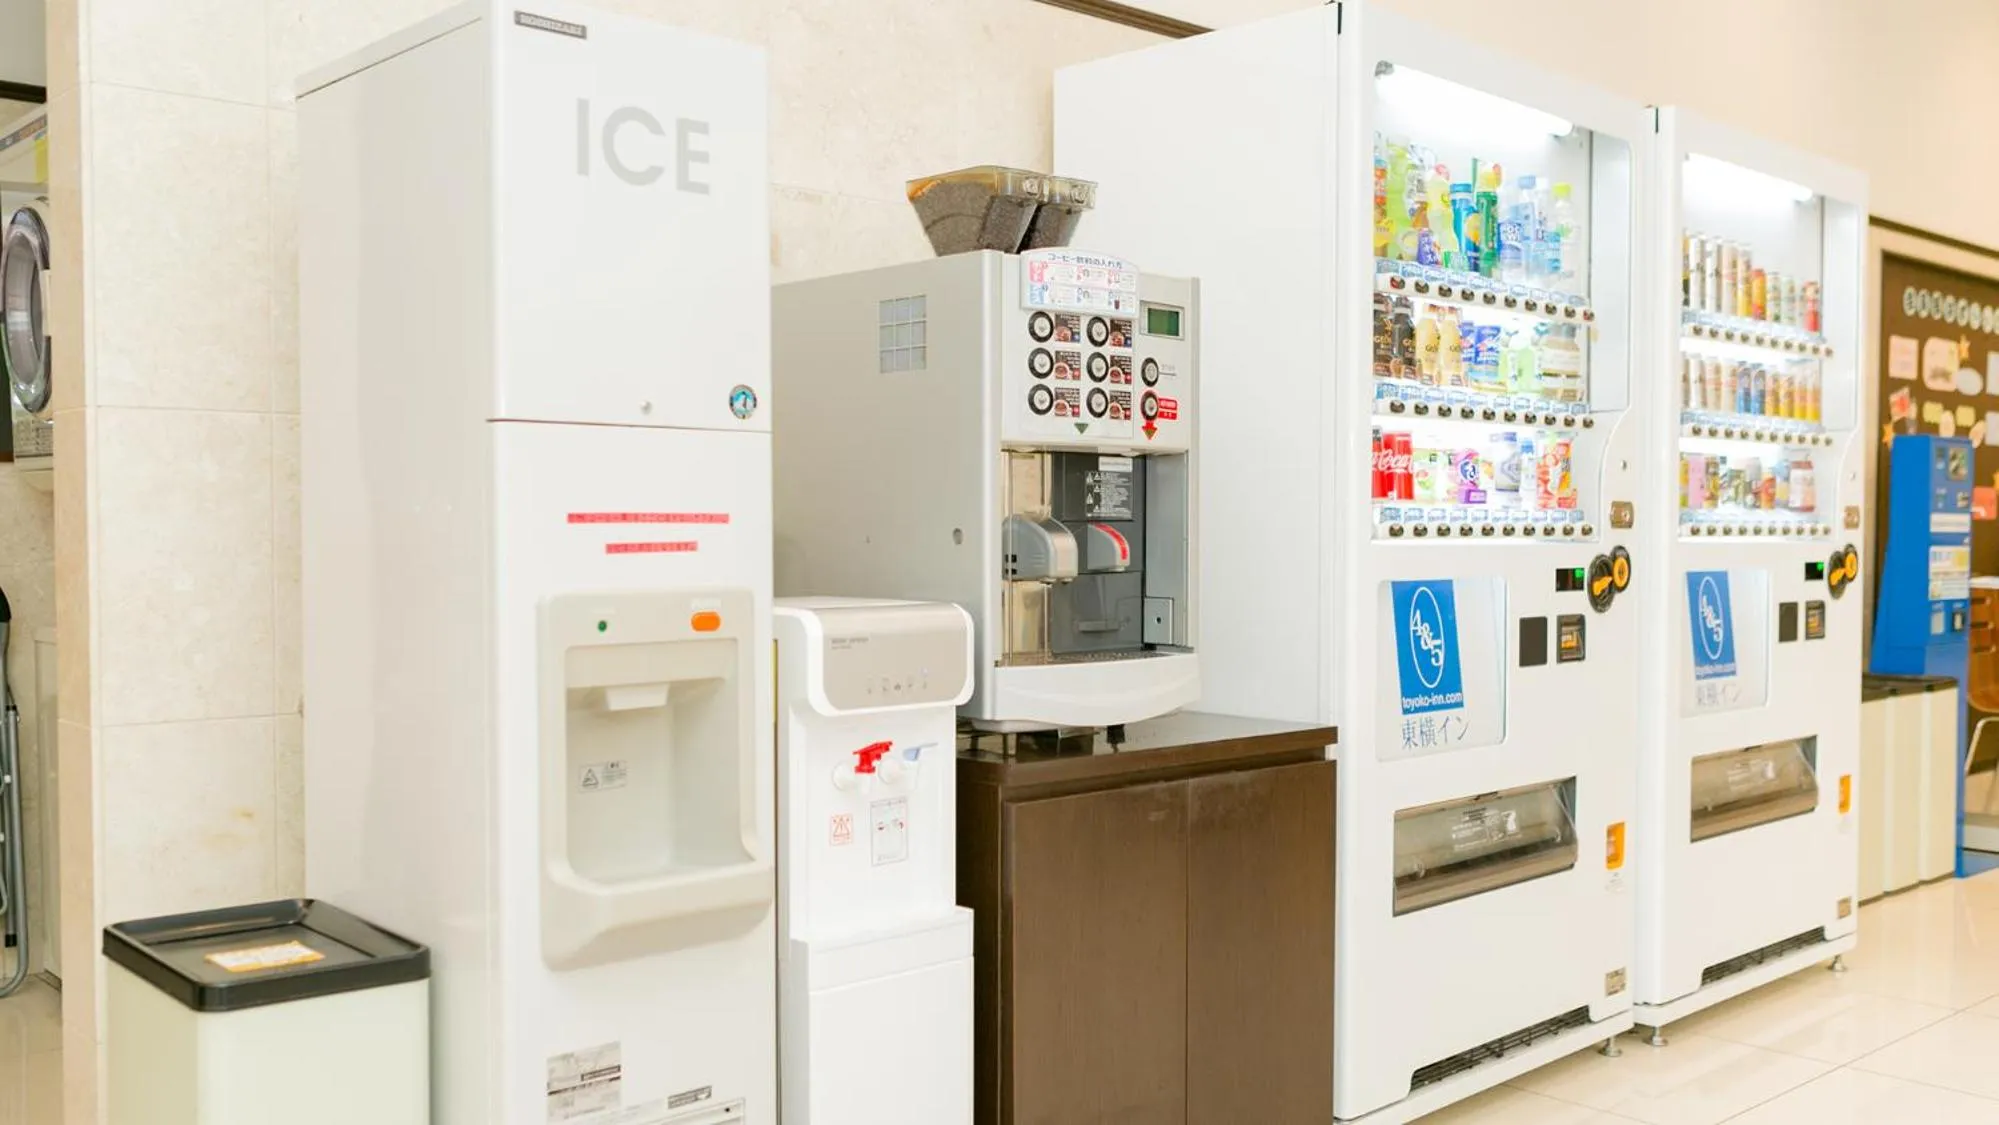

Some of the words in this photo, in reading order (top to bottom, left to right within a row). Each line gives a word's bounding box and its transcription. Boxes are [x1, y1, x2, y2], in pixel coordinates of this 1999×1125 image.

[577, 98, 709, 196] ICE
[1411, 608, 1443, 668] 4&5
[1402, 692, 1463, 711] toyoko-inn.com
[1401, 714, 1470, 750] 東横イン
